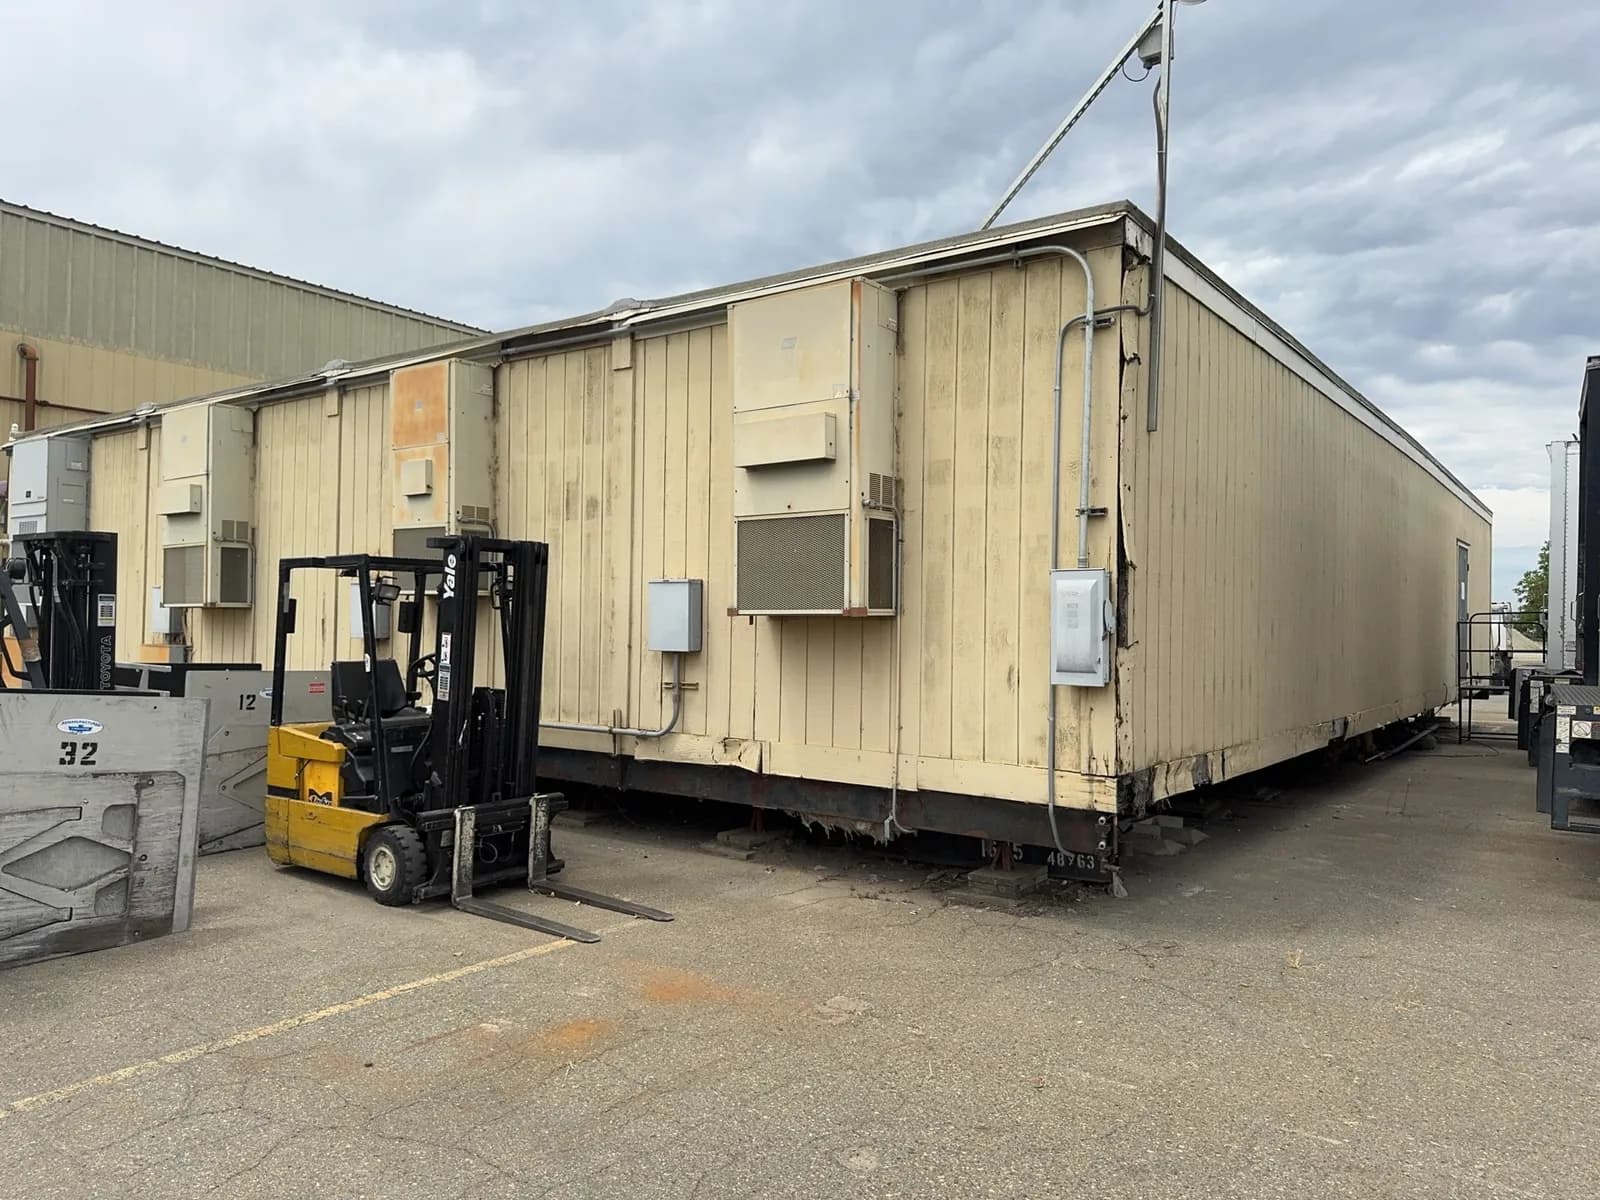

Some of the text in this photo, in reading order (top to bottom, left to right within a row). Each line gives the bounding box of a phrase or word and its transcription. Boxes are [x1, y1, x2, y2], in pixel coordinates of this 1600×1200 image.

[443, 554, 457, 599] Yale
[100, 634, 112, 690] TOYOTA
[239, 694, 257, 710] 12
[59, 741, 98, 766] 32
